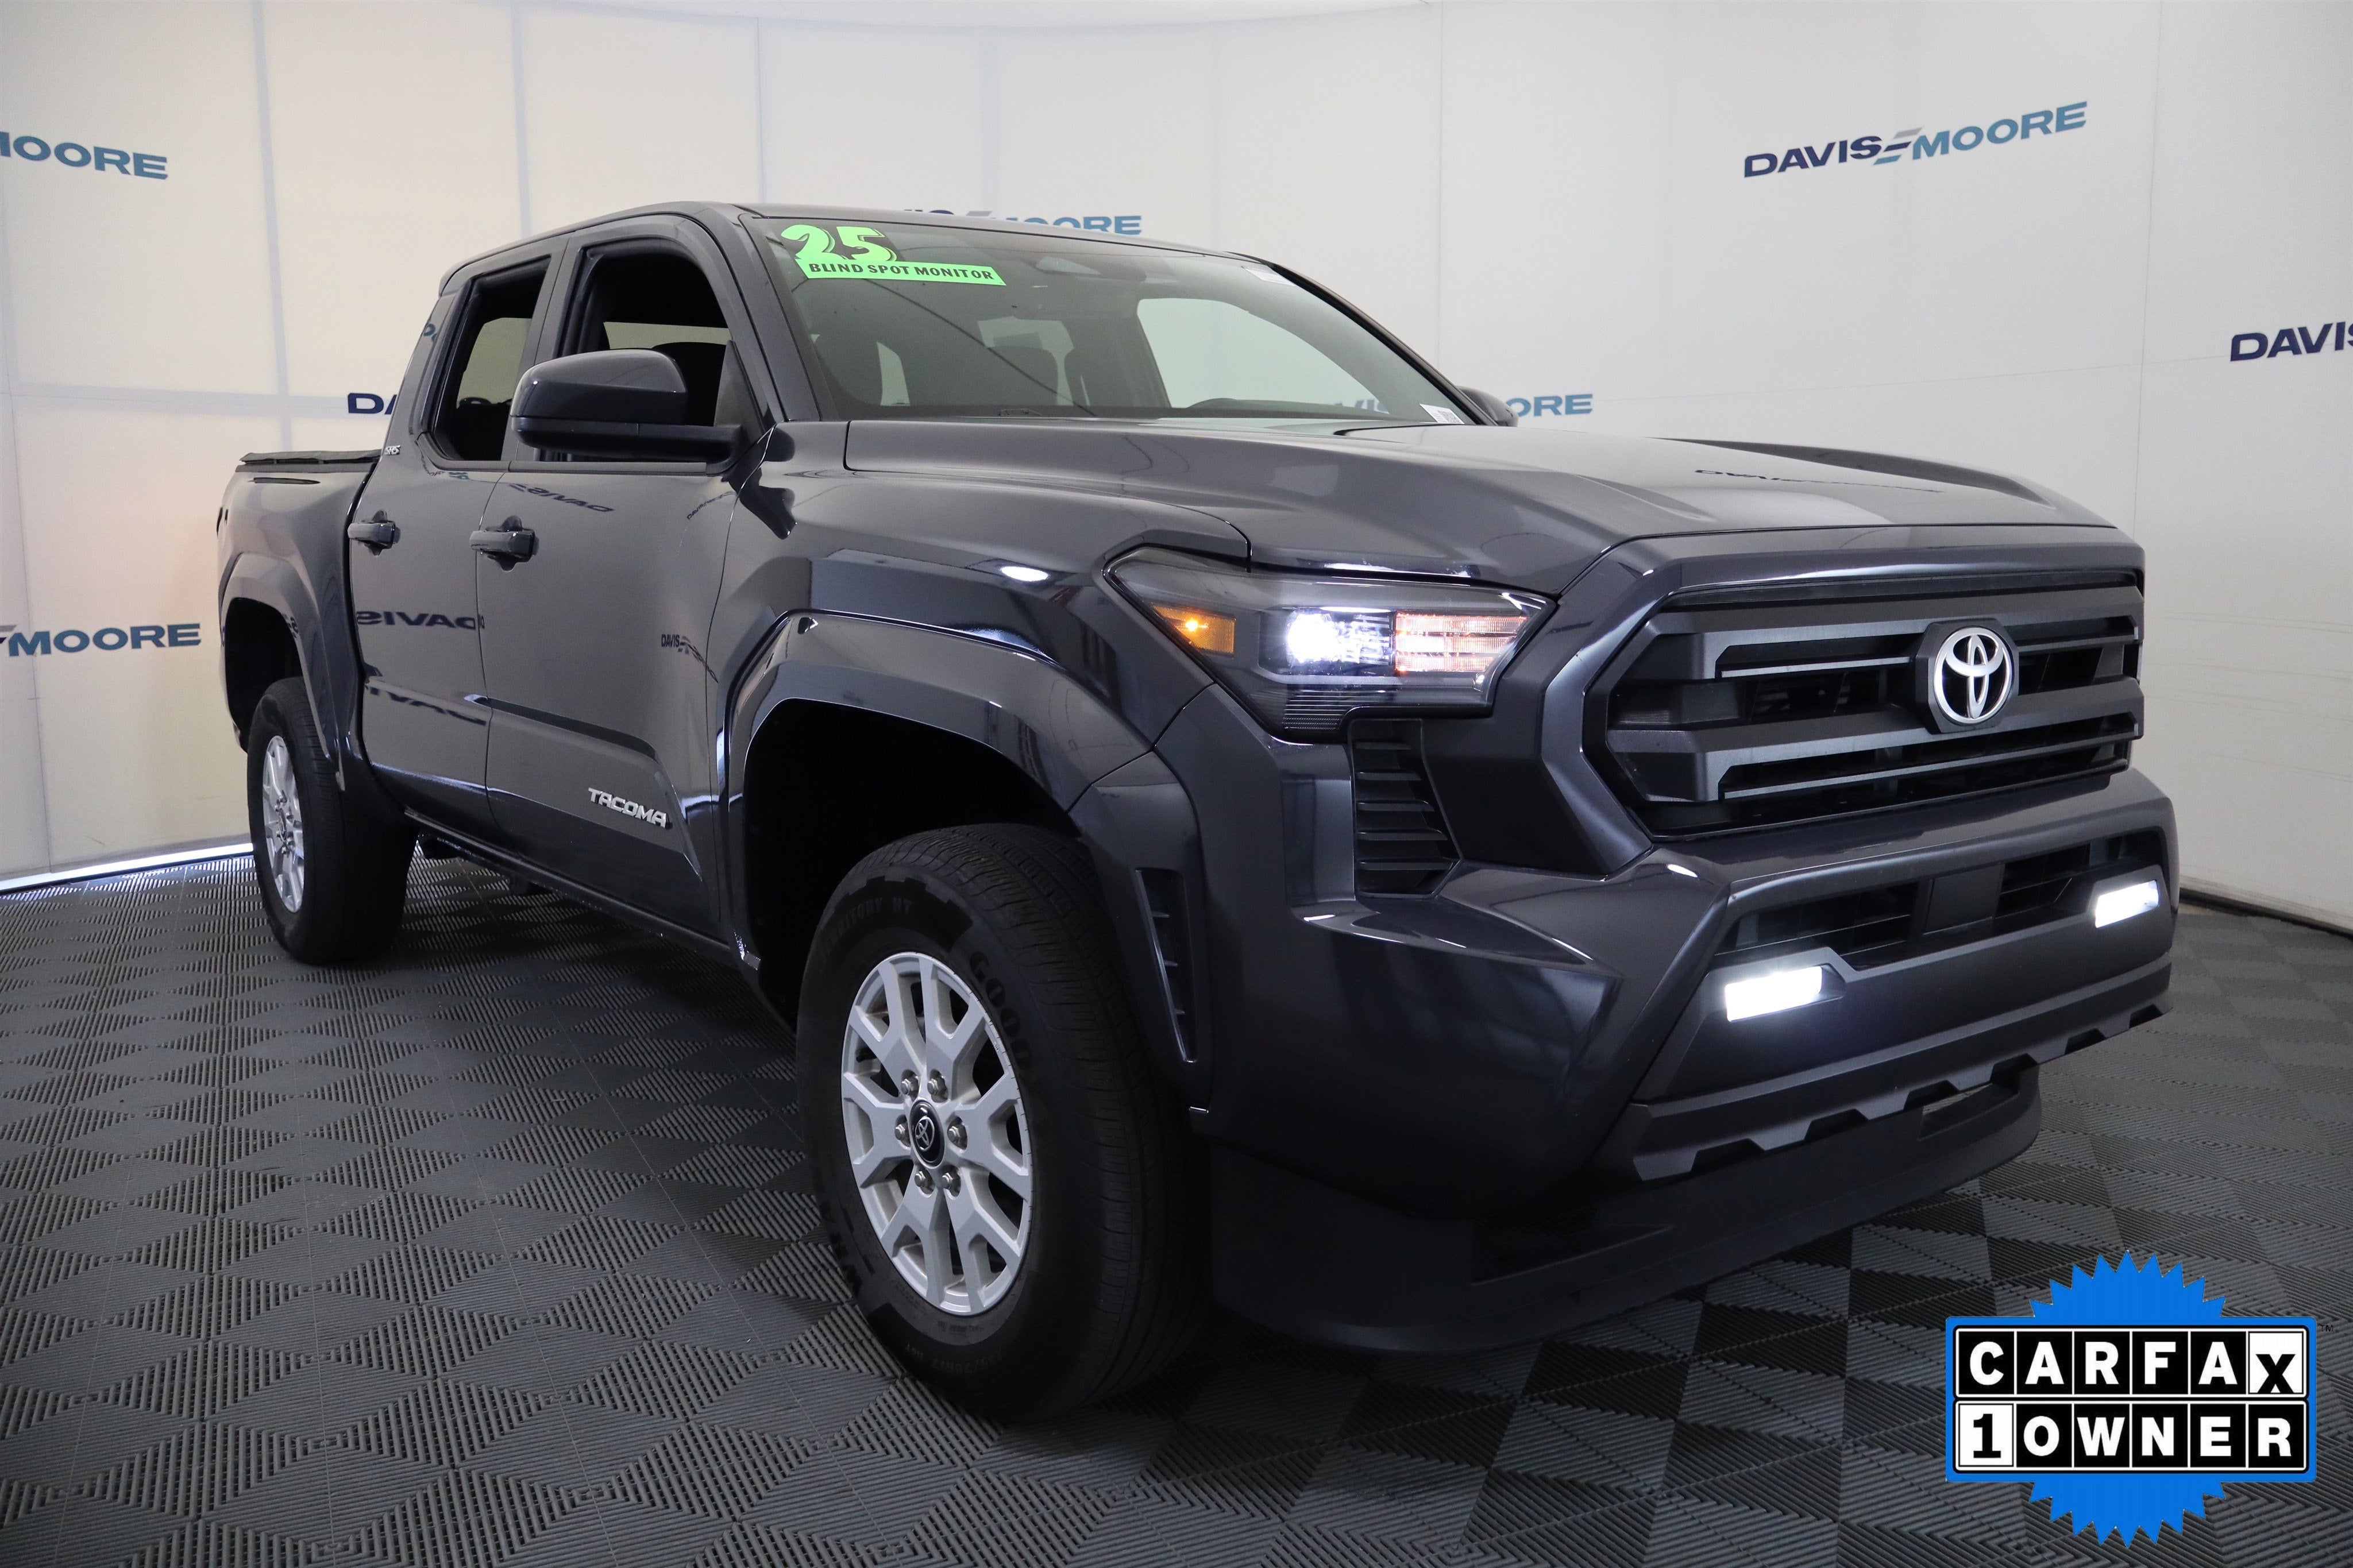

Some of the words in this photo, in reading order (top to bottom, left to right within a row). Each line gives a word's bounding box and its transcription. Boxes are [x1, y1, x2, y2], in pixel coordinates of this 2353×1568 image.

[1744, 135, 1883, 178] DAVIS
[1912, 101, 2088, 161] MOORE
[780, 224, 897, 262] 25
[809, 262, 864, 274] BLIND
[869, 264, 910, 275] SPOT
[913, 266, 995, 280] MONITOR
[2229, 320, 2353, 362] DAVI
[8, 623, 202, 657] MOORE
[588, 787, 667, 828] TACOMA
